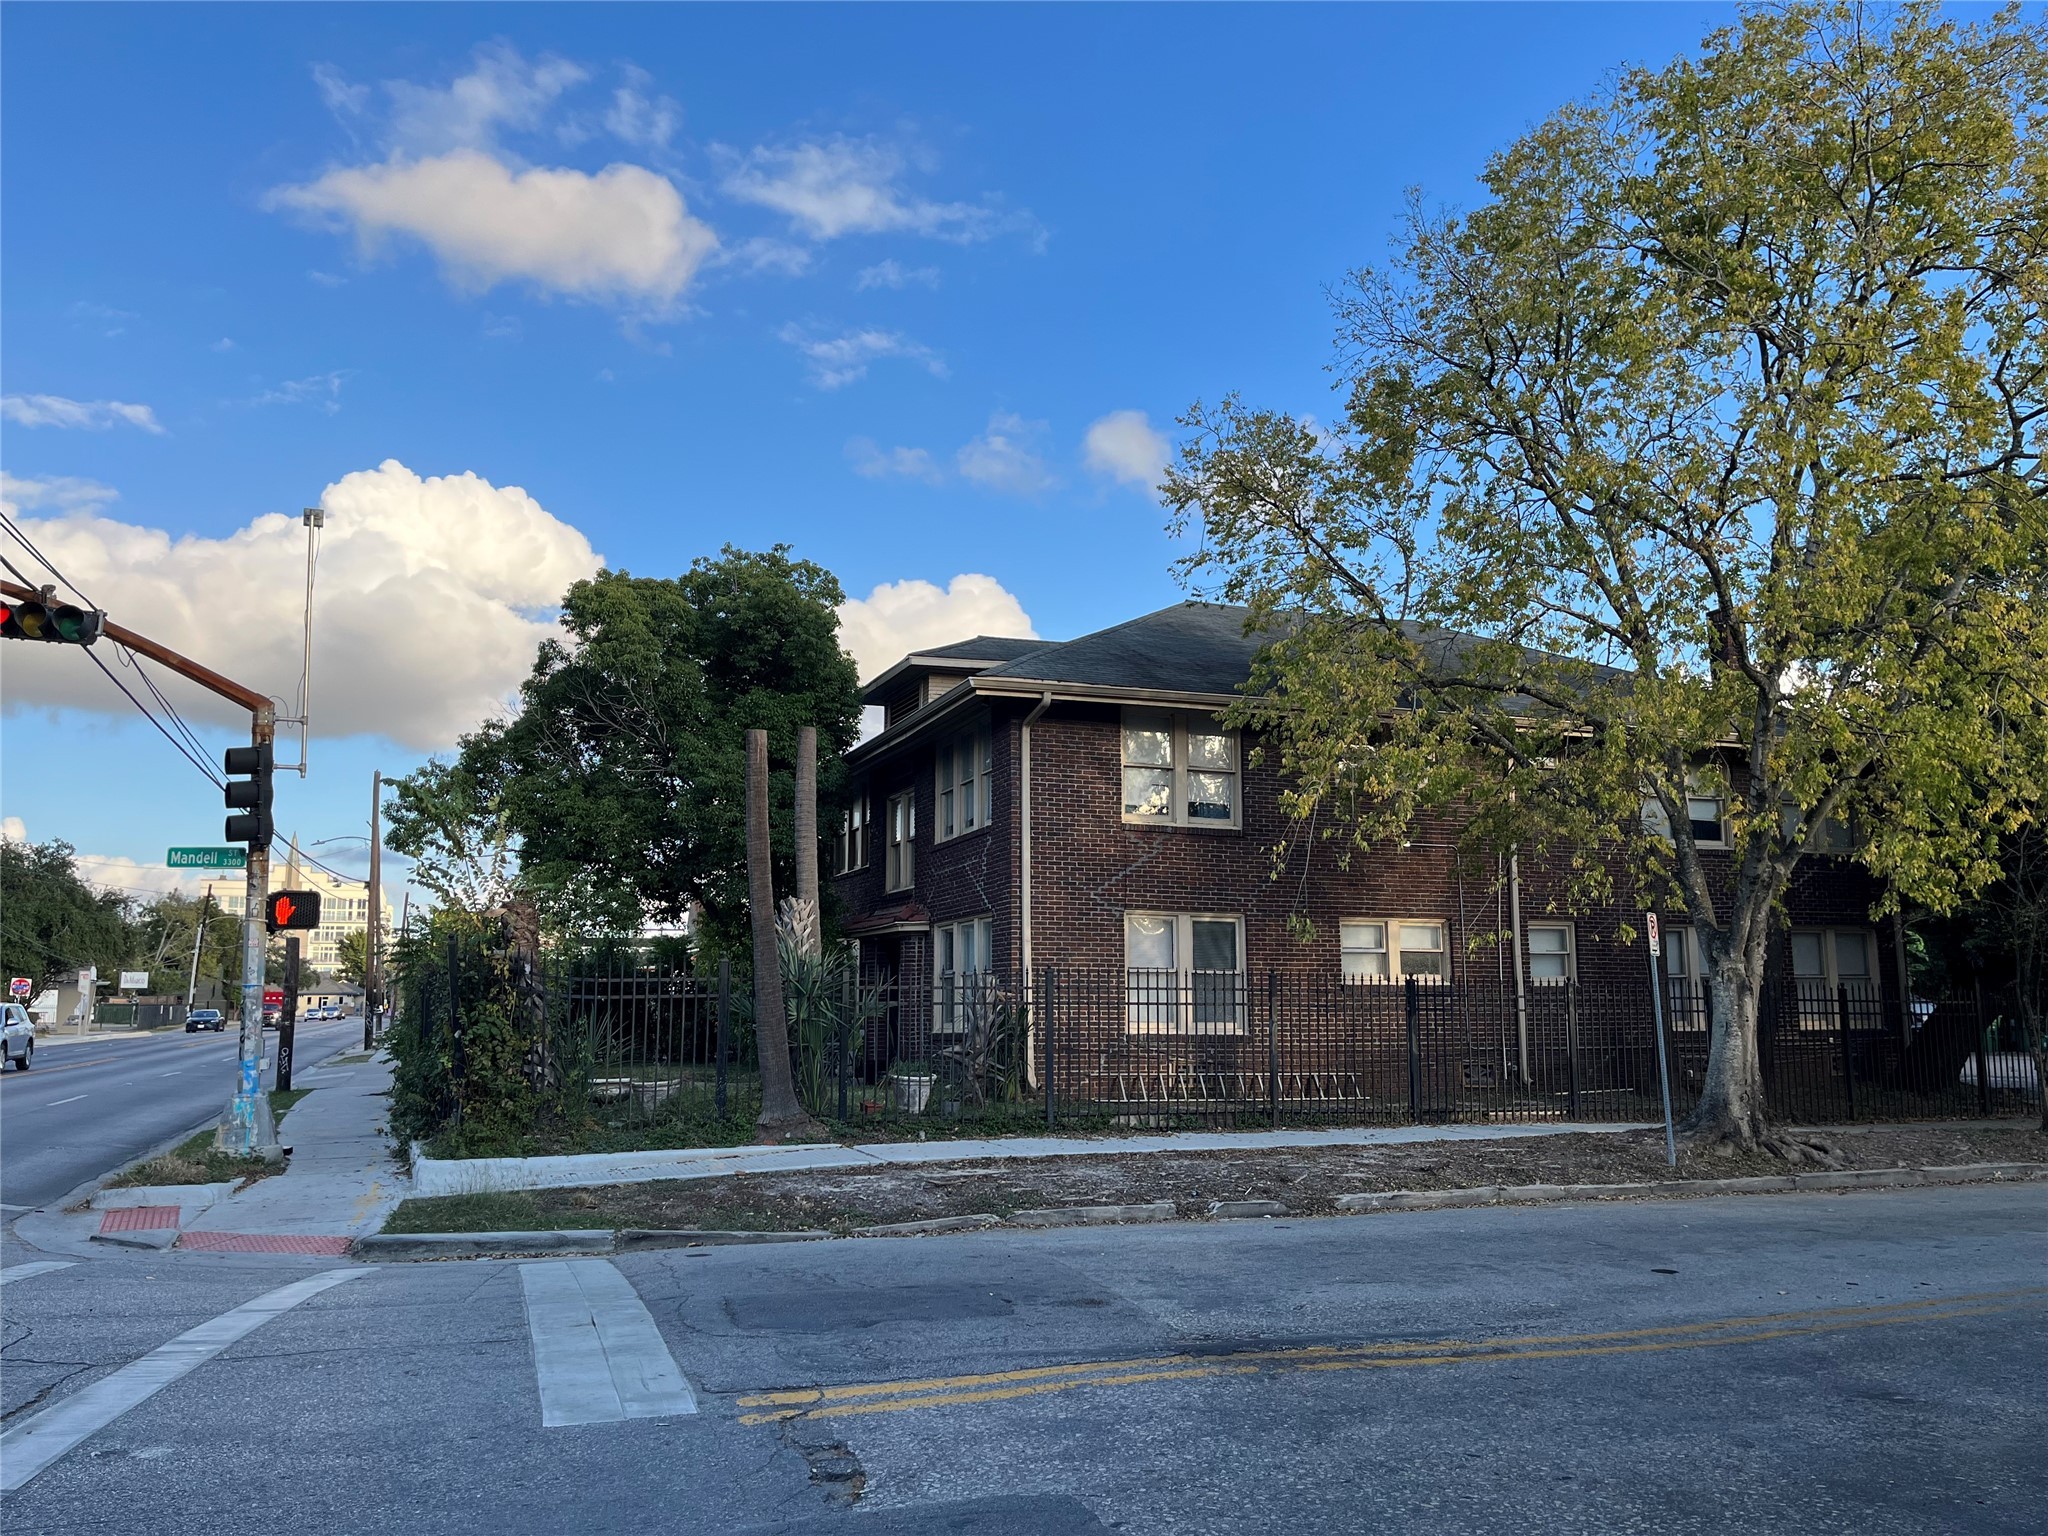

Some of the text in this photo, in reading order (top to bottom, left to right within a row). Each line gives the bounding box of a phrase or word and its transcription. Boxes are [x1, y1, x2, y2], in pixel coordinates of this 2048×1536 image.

[170, 849, 238, 864] Mandell ST
[222, 858, 241, 866] 3300
